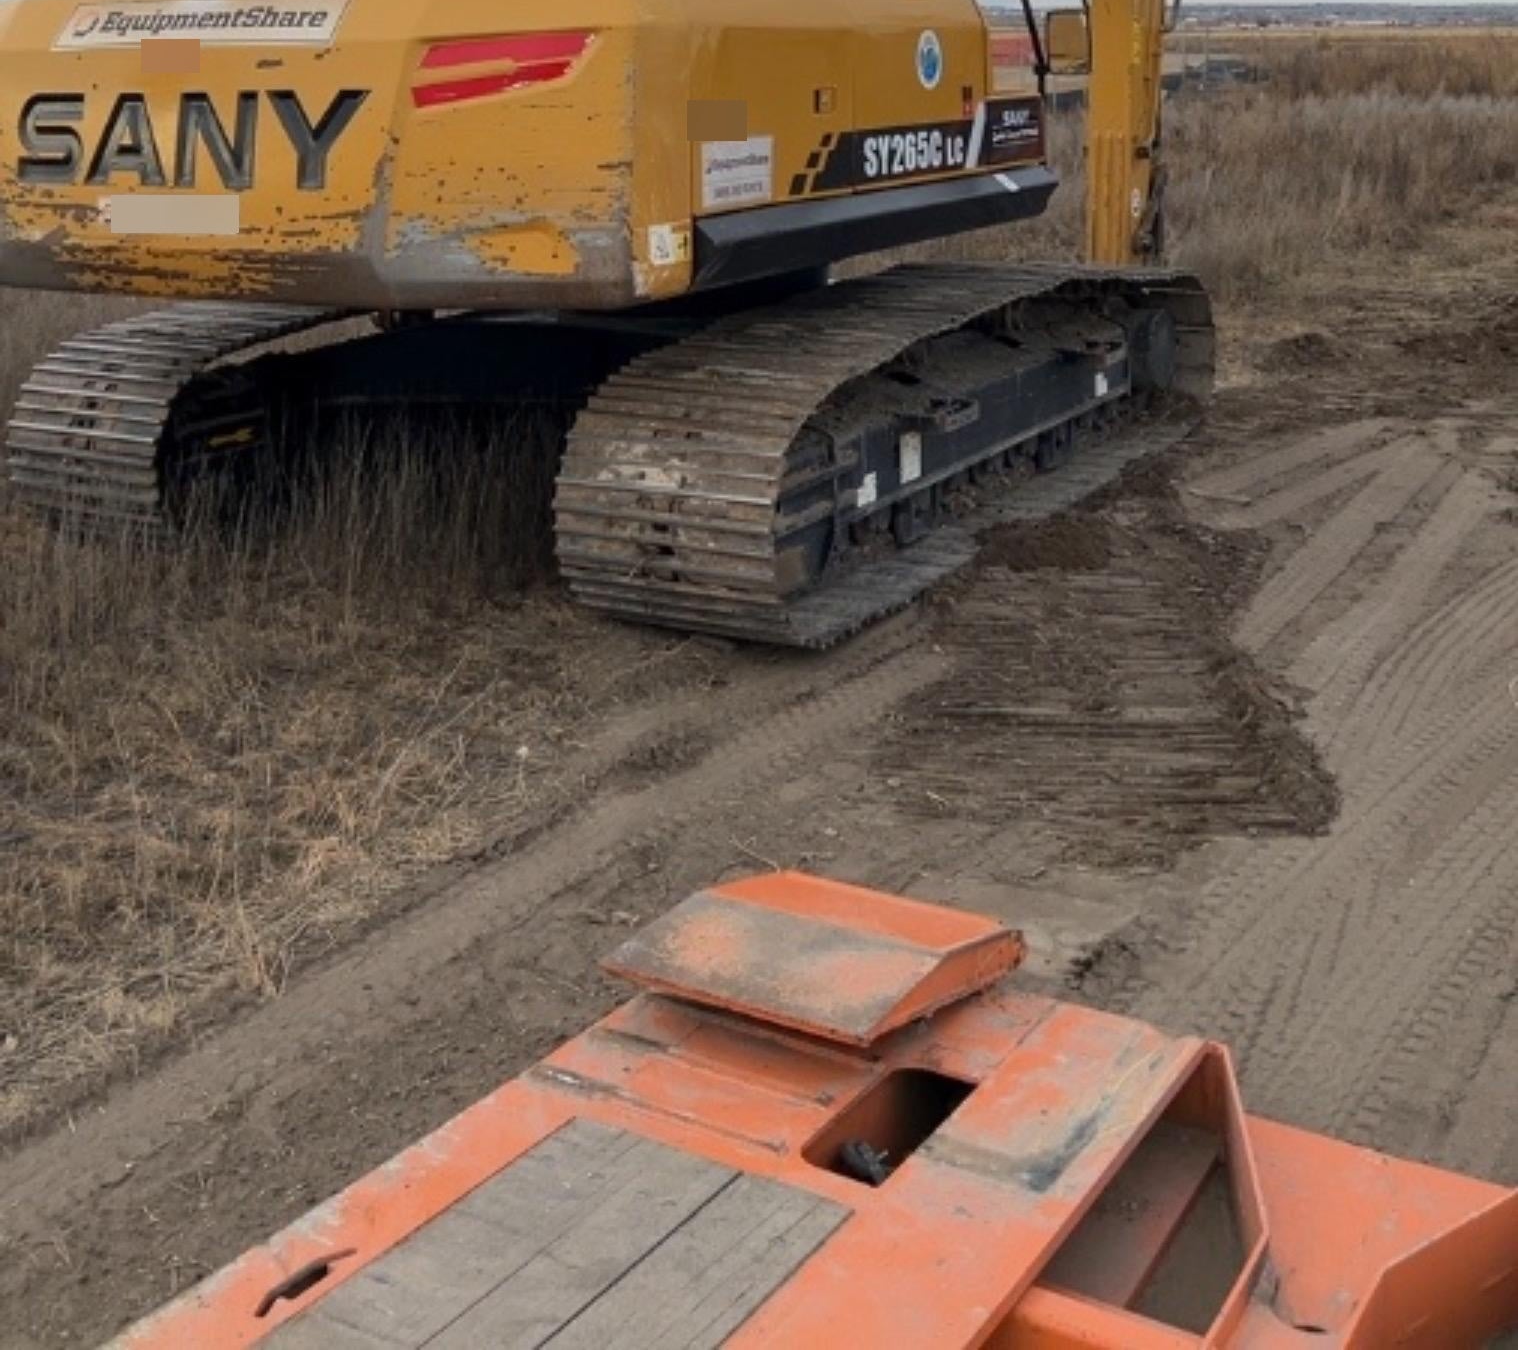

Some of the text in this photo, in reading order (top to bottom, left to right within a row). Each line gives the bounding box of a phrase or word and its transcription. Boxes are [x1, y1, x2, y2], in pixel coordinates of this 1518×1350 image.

[100, 5, 328, 36] EquipmentShare
[17, 89, 372, 191] SANY
[863, 130, 964, 178] SY265C LC
